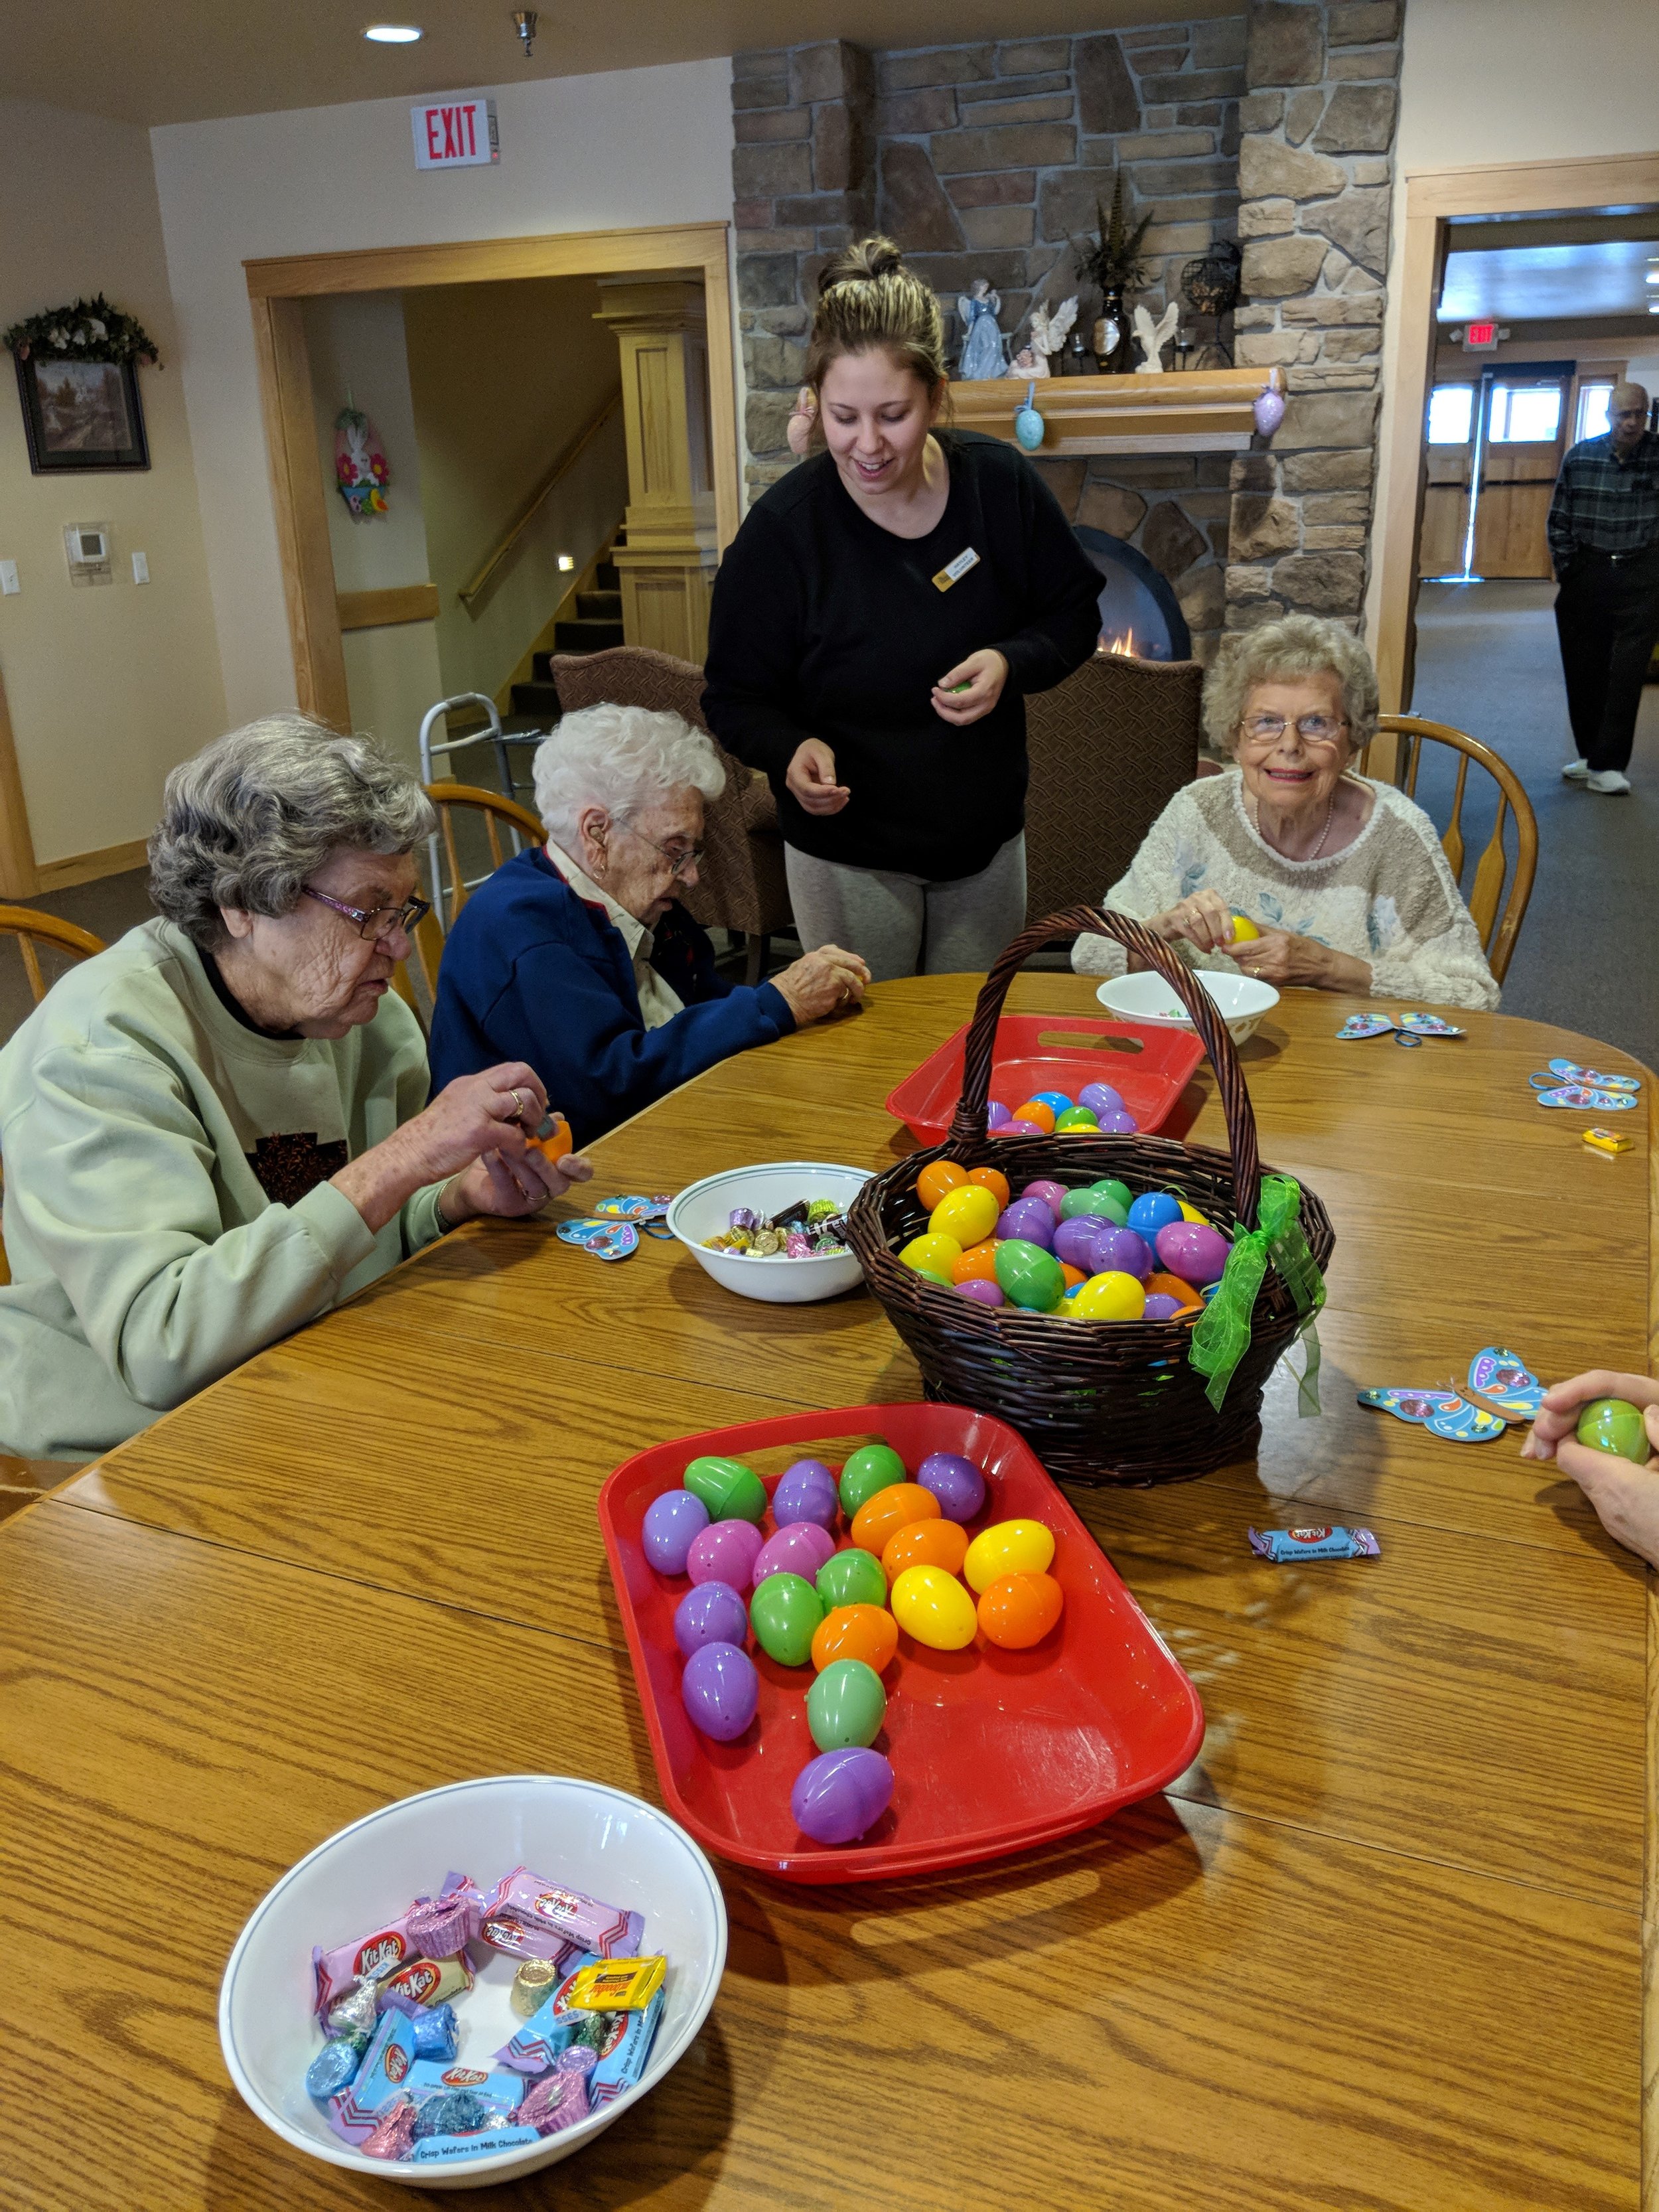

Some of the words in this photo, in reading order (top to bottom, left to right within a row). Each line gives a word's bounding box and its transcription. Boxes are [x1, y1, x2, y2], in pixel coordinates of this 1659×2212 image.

[425, 105, 476, 159] EXIT
[1469, 325, 1494, 344] EXIT
[441, 2146, 469, 2155] Wafers
[480, 2140, 496, 2150] Milk
[498, 2138, 533, 2148] Chocolate
